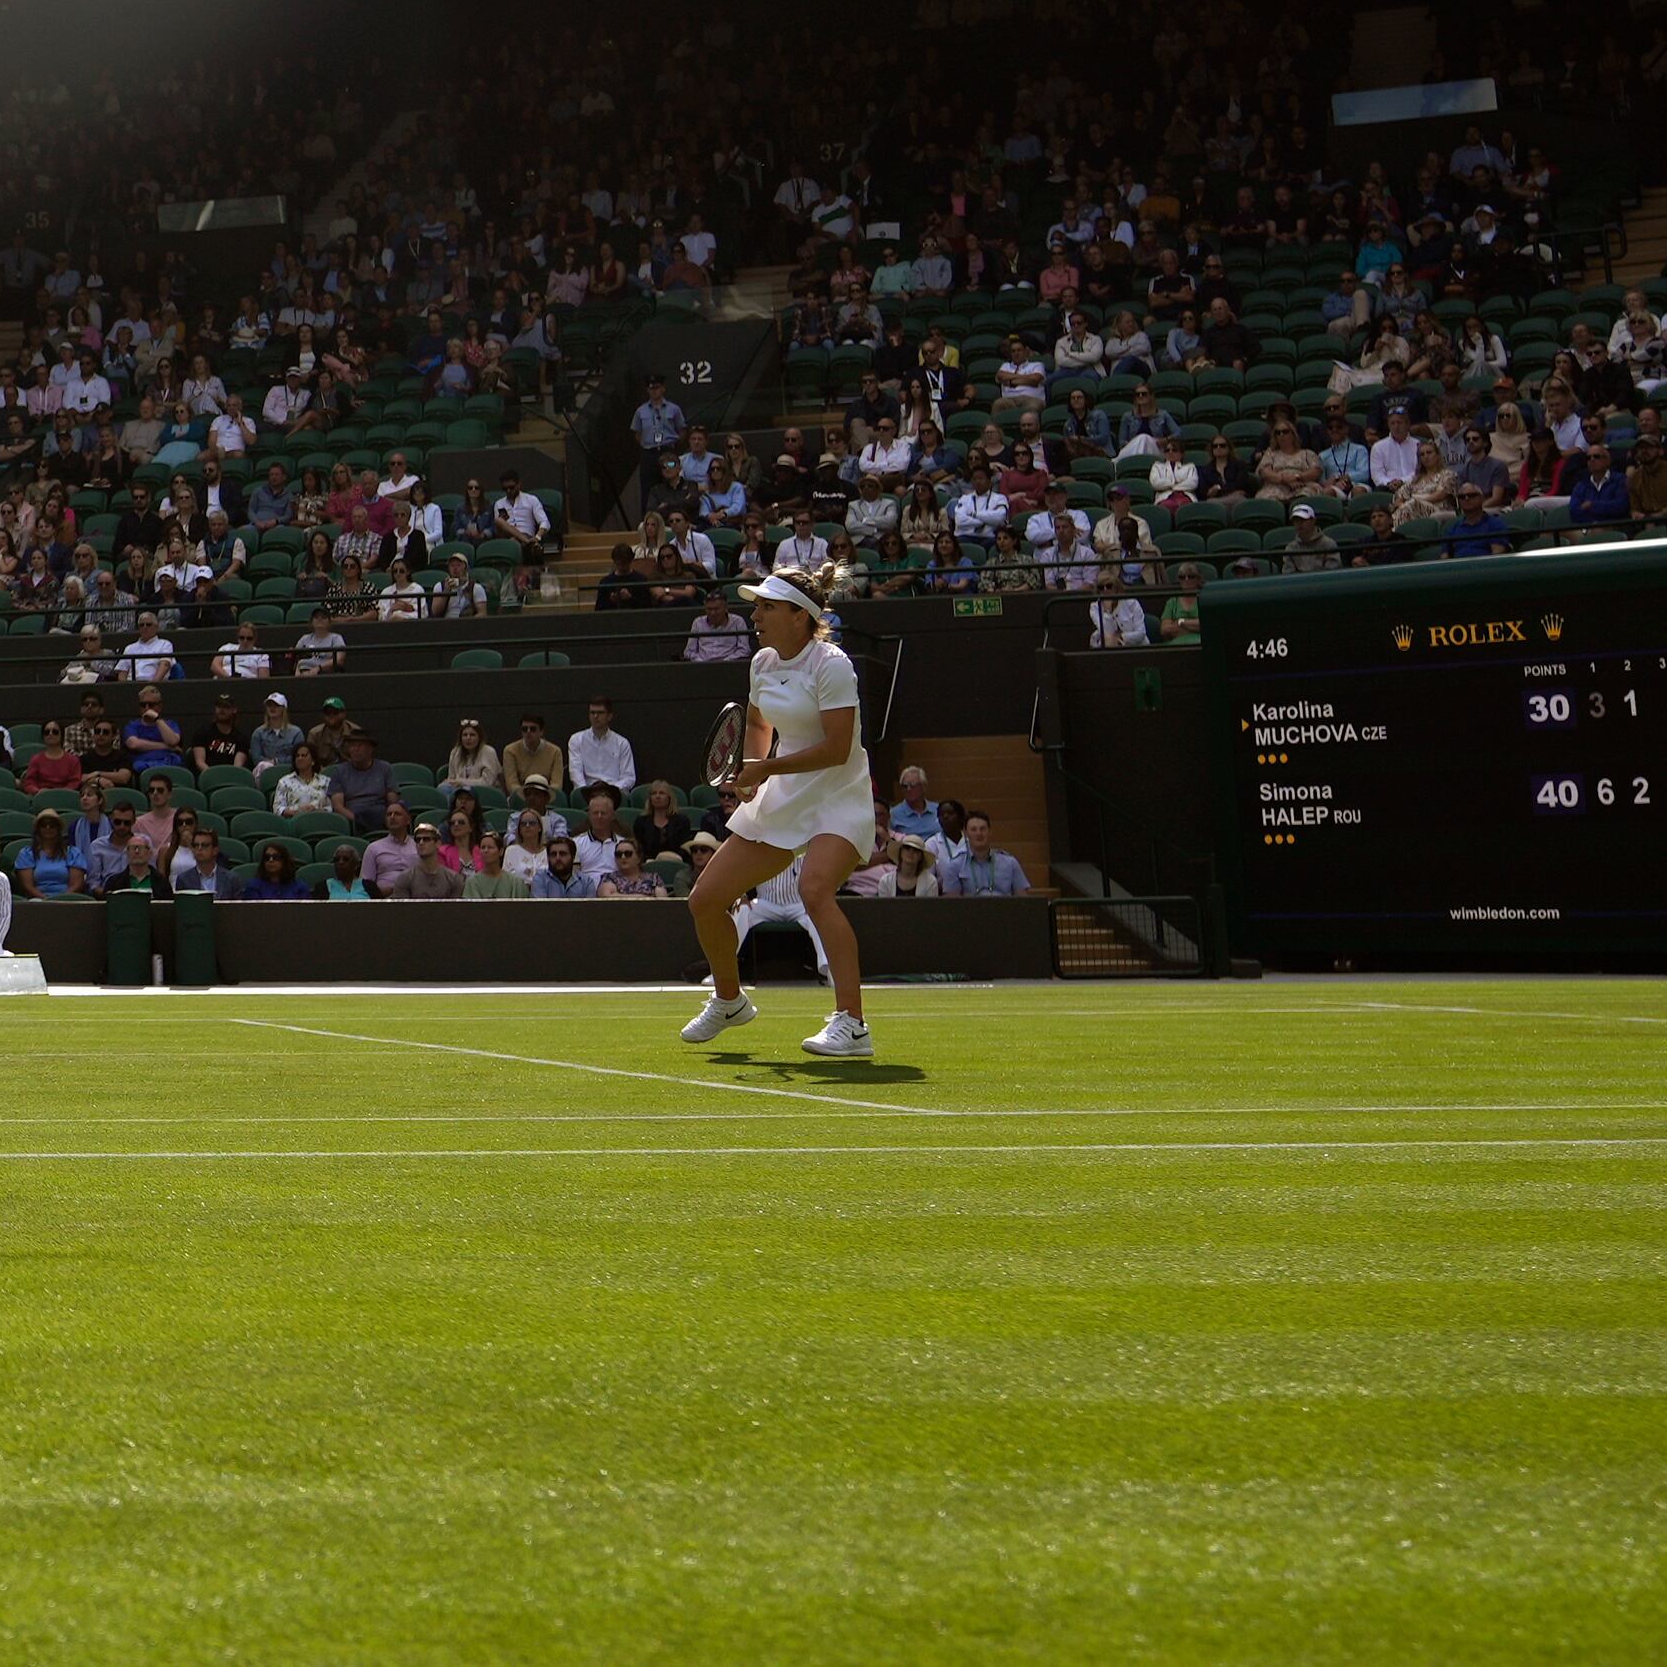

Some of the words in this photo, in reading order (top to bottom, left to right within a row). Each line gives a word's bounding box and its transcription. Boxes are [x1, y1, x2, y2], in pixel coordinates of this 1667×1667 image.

[820, 142, 845, 163] 37
[26, 211, 49, 229] 35
[680, 360, 712, 384] 32
[1428, 619, 1527, 647] ROLEX
[1246, 637, 1289, 659] 4:46
[1523, 662, 1567, 677] POINTS
[1589, 661, 1596, 674] 1
[1623, 658, 1632, 672] 2
[1659, 656, 1667, 670] 3
[1252, 699, 1334, 722] Karolina
[1528, 693, 1571, 723] 30
[1588, 691, 1606, 719] 3
[1623, 688, 1638, 717] 1
[1254, 723, 1358, 747] MUCHOVA
[1361, 725, 1388, 741] CZE
[1259, 782, 1333, 802] Simona
[1536, 779, 1579, 809] 40
[1597, 777, 1616, 806] 6
[1632, 776, 1651, 805] 2
[1261, 805, 1329, 827] HALEP
[1333, 808, 1362, 825] ROU
[1450, 906, 1560, 920] wimbledon.com
